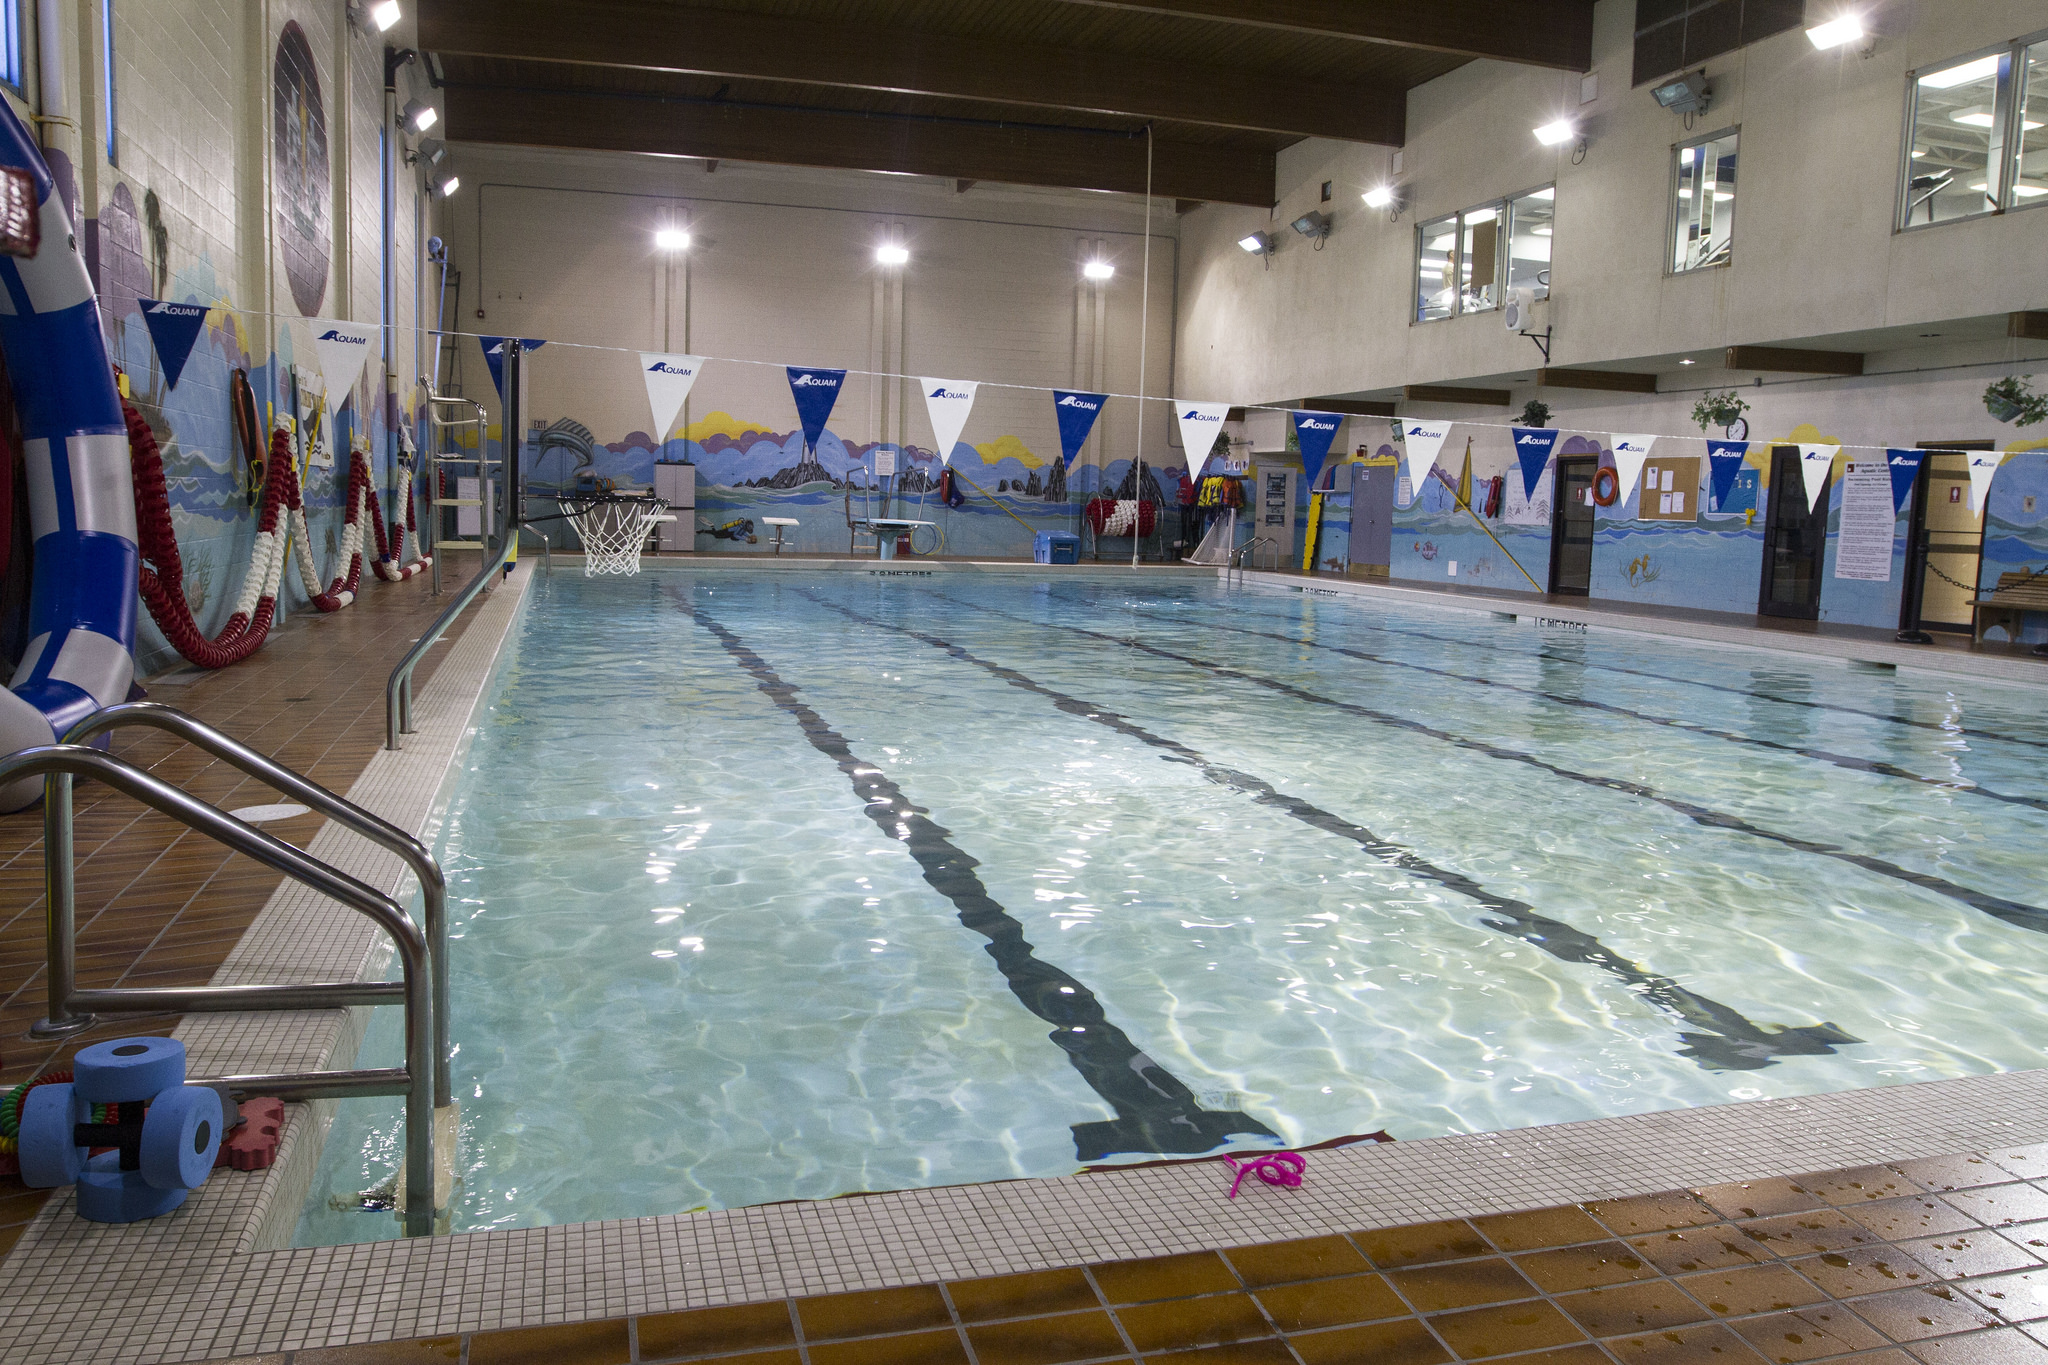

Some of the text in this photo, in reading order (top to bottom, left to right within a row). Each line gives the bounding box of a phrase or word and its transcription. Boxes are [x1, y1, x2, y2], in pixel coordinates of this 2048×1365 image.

[147, 302, 199, 317] AQUAM
[318, 330, 366, 345] AQUAM
[648, 361, 692, 376] AQUAM
[793, 374, 837, 387] AQUAM
[928, 388, 969, 399] AQUAM
[1058, 395, 1097, 410] AQUAM
[1182, 411, 1220, 422] AQUAM
[533, 420, 547, 430] EXIT
[1299, 418, 1335, 431] AQUAM
[1407, 427, 1442, 438] AQUAM
[1517, 435, 1551, 446] AQUAM
[1711, 447, 1742, 458] AQUAM
